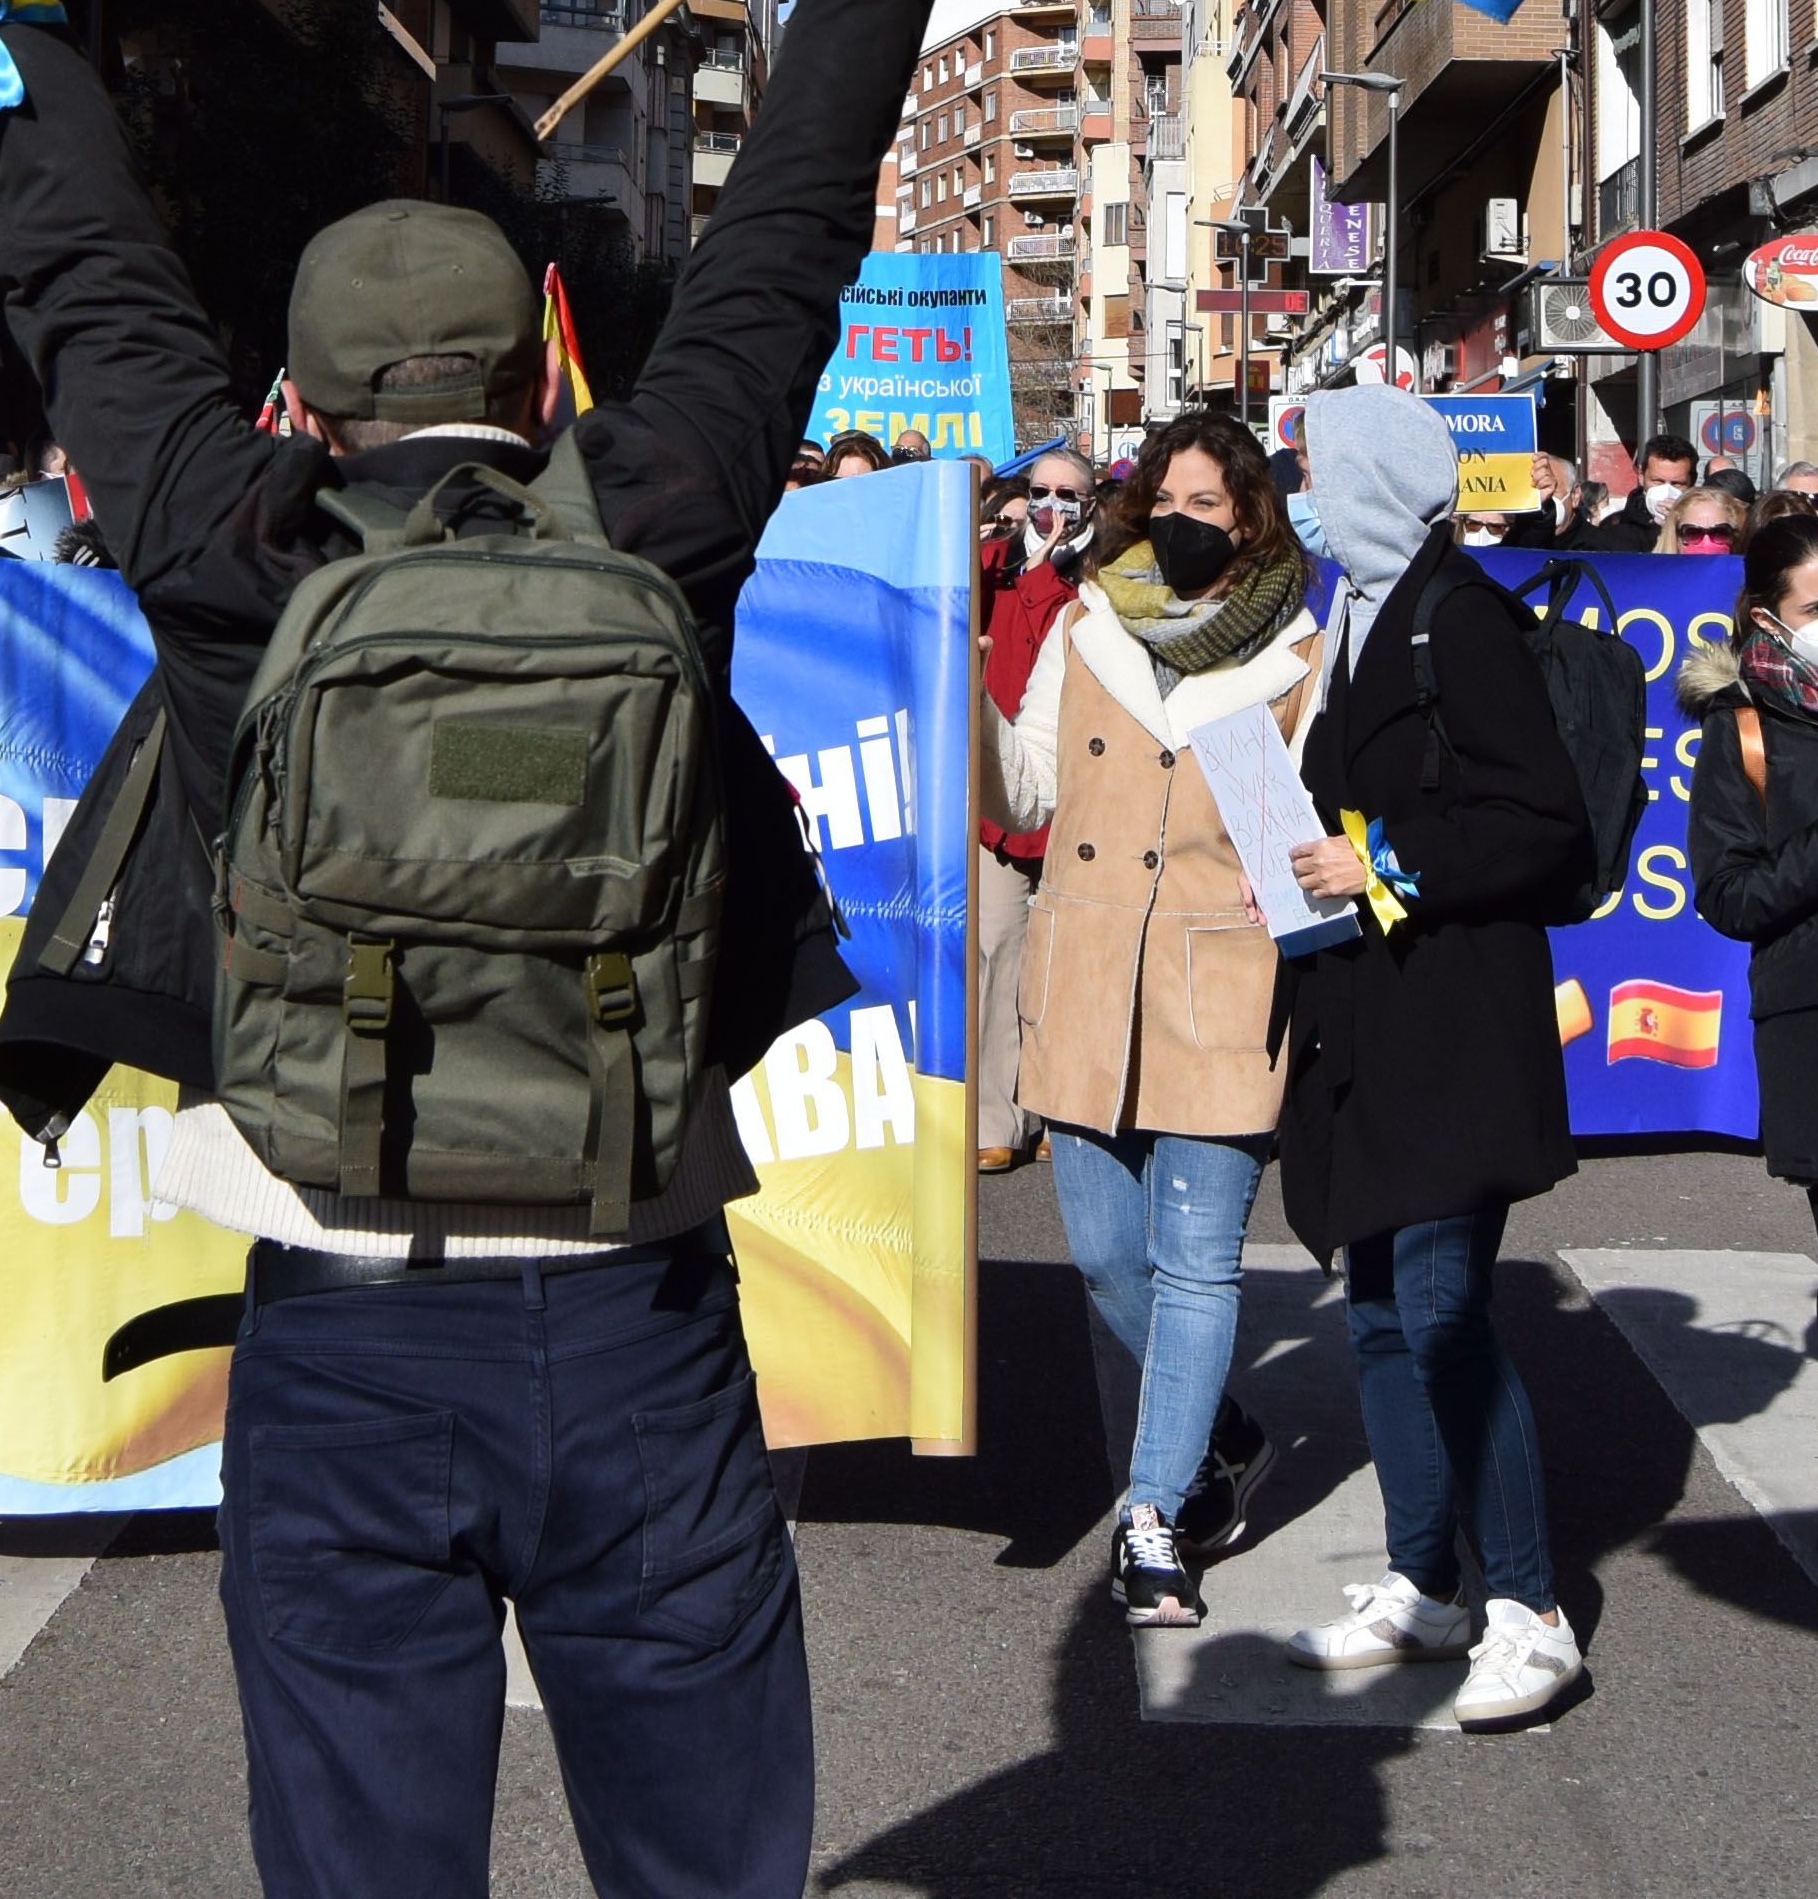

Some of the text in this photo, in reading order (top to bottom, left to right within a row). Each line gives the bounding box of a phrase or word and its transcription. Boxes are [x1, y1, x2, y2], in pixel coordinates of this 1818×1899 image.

[1318, 172, 1334, 270] QUERIA
[1344, 205, 1362, 270] ENESE
[842, 284, 987, 309] сійські окупанти
[1615, 271, 1677, 308] 30
[846, 325, 972, 362] ГЕТЬ!
[838, 373, 982, 402] української
[822, 407, 983, 449] ЗЕМЛІ
[1444, 414, 1506, 433] MORA
[1458, 447, 1486, 464] ON
[1461, 476, 1507, 493] ANIA
